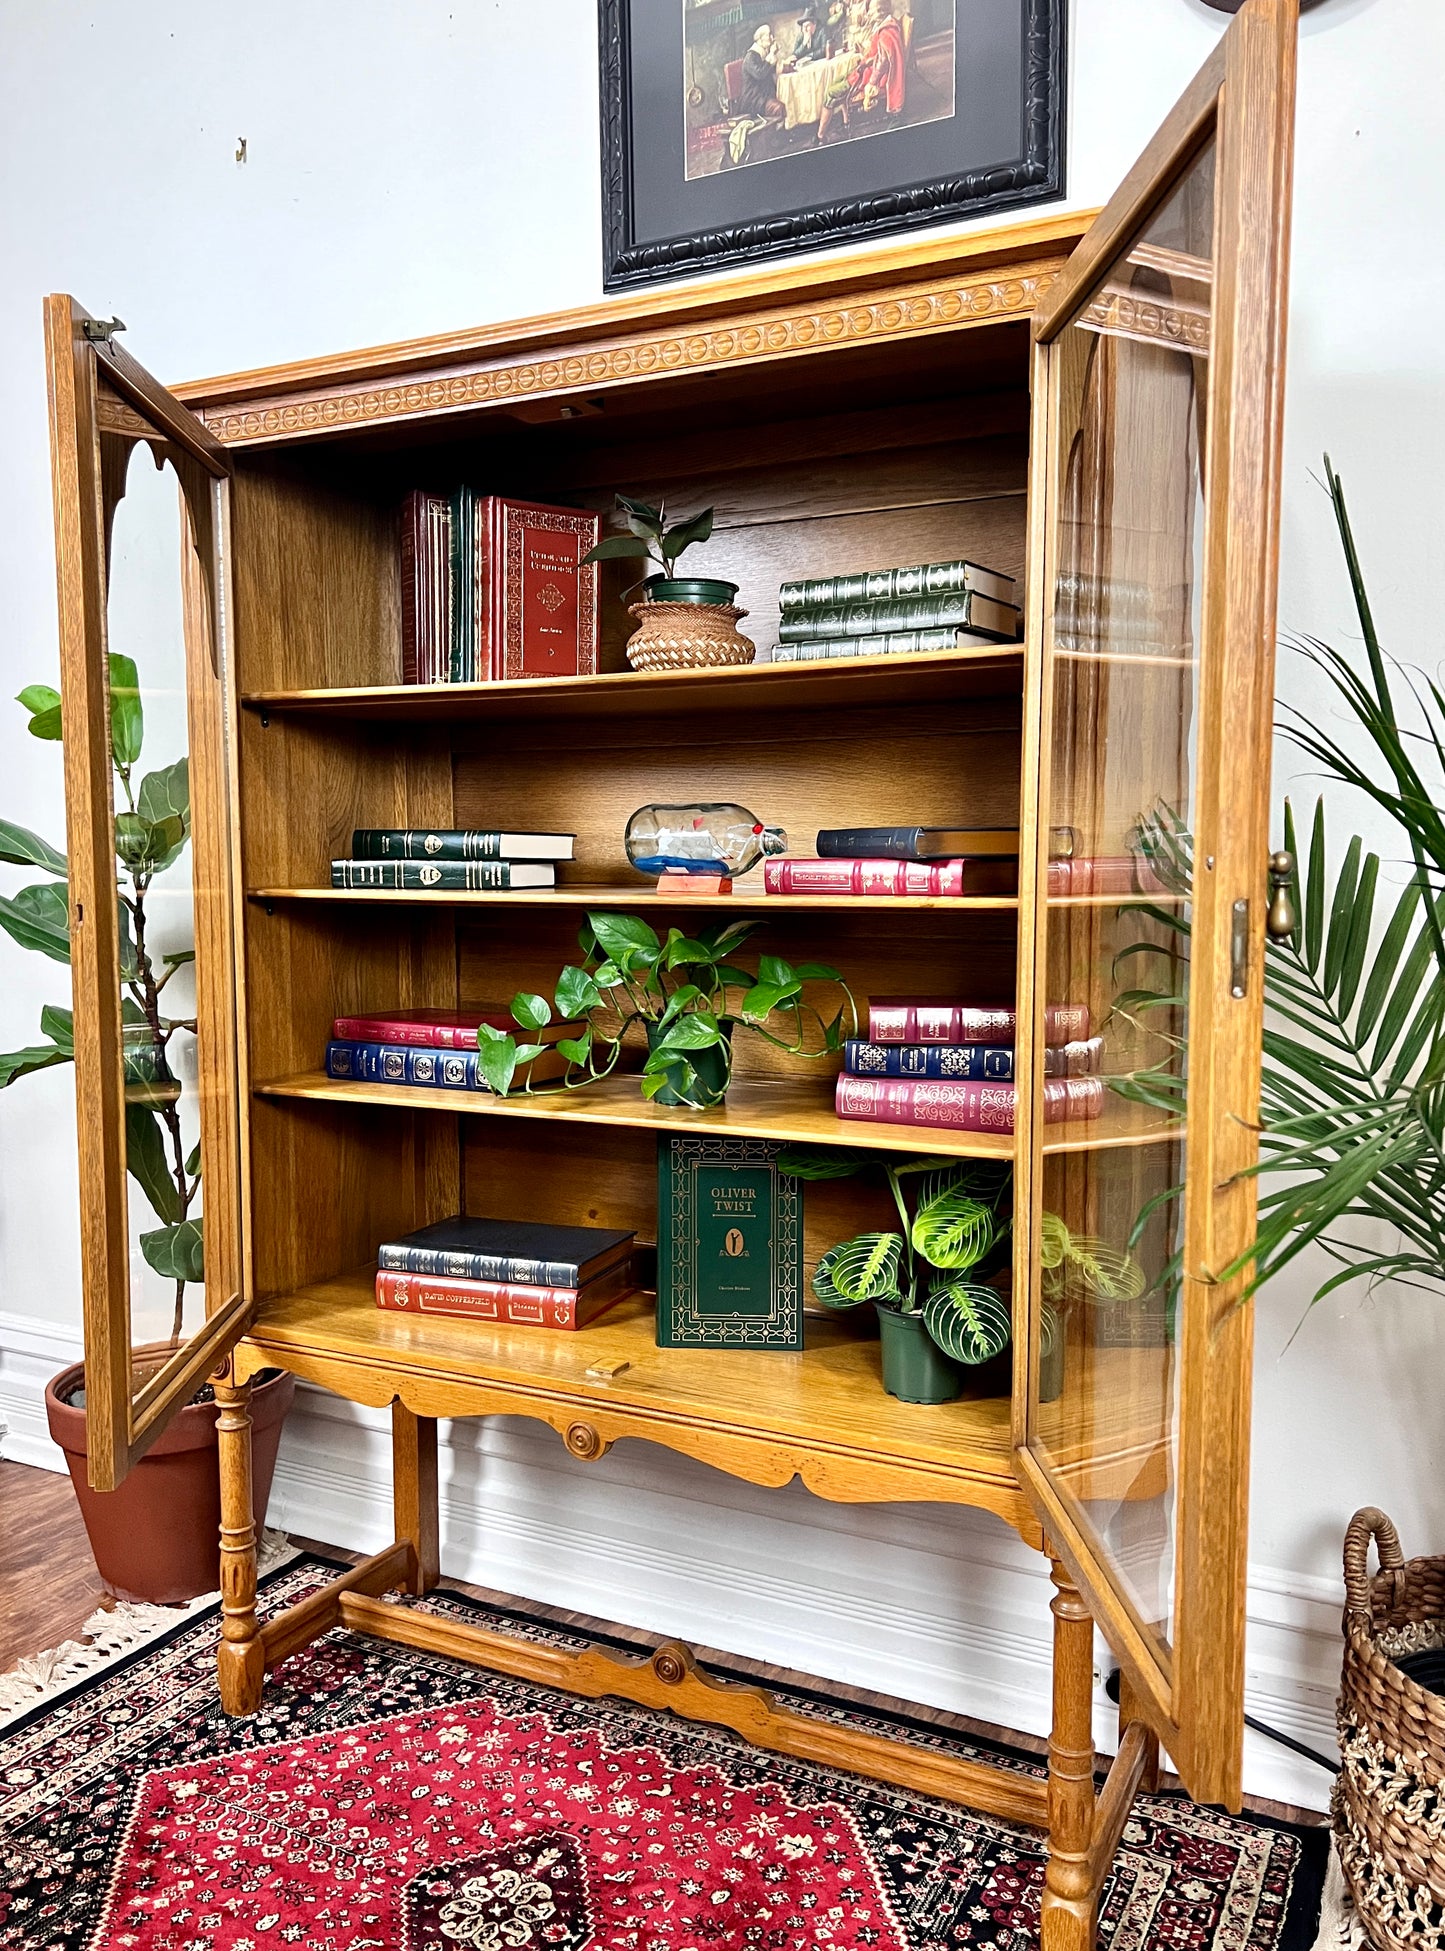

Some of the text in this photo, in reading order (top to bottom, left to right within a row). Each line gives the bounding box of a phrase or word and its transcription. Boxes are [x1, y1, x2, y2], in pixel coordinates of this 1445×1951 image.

[711, 1187, 757, 1199] OLIVER
[714, 1200, 753, 1212] TWIST
[424, 1292, 491, 1306] DAVID COPPERFIELD
